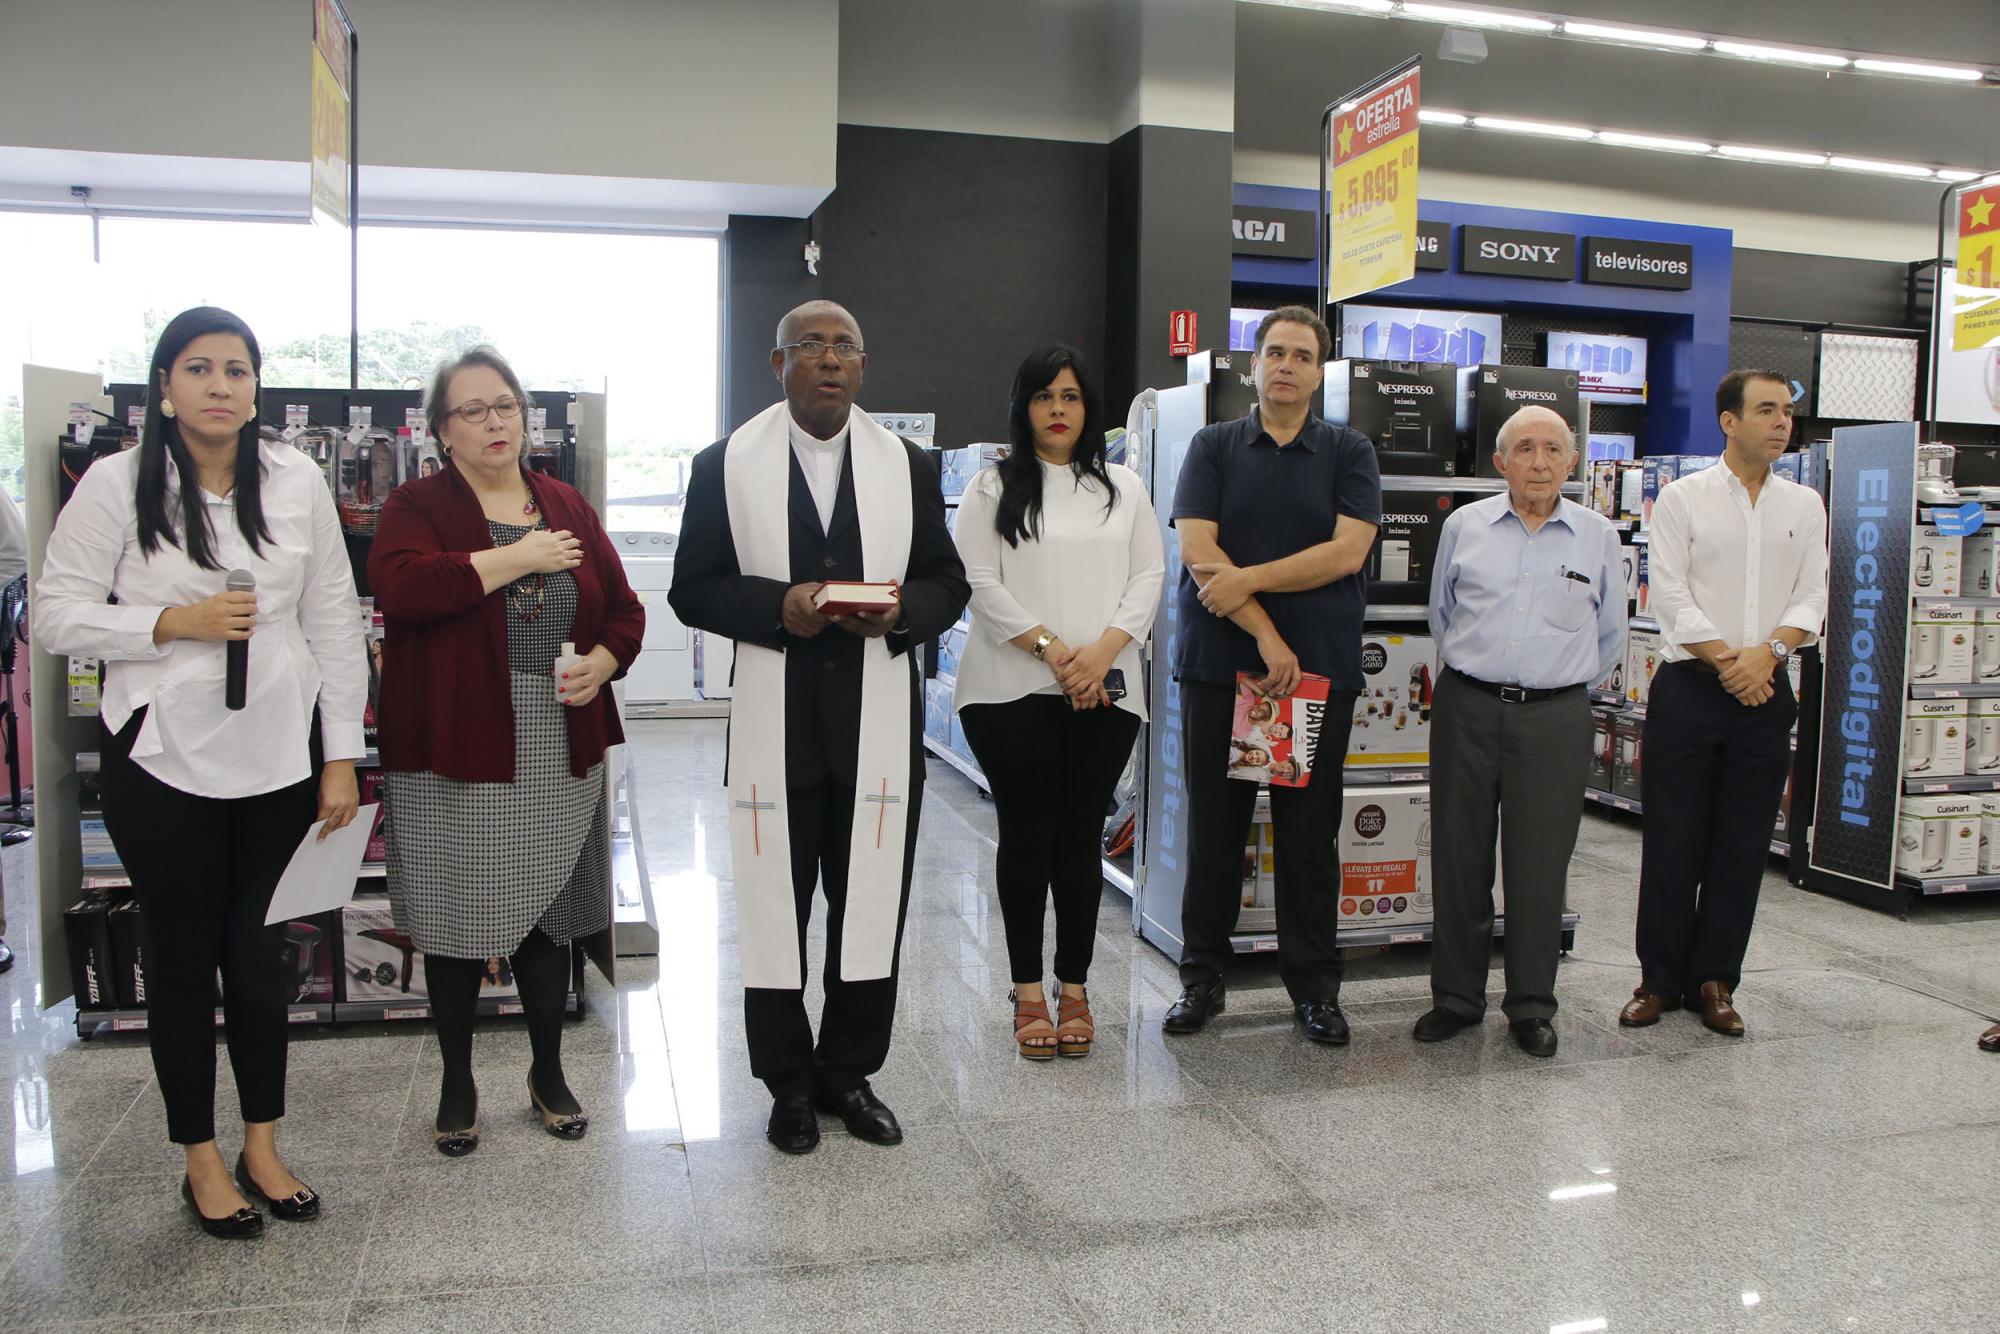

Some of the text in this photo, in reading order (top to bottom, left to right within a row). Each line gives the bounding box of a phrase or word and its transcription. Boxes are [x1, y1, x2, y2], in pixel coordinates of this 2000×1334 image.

[1356, 84, 1414, 132] OFERTA
[1367, 115, 1400, 143] estrella
[1232, 219, 1285, 242] RCA
[1415, 236, 1438, 253] NG
[1480, 241, 1561, 264] SONY
[1594, 251, 1688, 275] televisores
[1376, 381, 1434, 395] NESPRESSO
[1504, 387, 1557, 401] NESPRESSO
[1381, 513, 1428, 524] ESPRESSO
[1929, 610, 1962, 619] Cuisinart
[1840, 469, 1888, 826] Electrodigital
[1923, 704, 1955, 712] Cuisinart
[1937, 804, 1970, 814] Cuisinart
[1981, 803, 1995, 811] nart
[1383, 863, 1407, 872] REGALO
[86, 964, 100, 1004] TAIFF
[133, 963, 146, 1003] TAIFF
